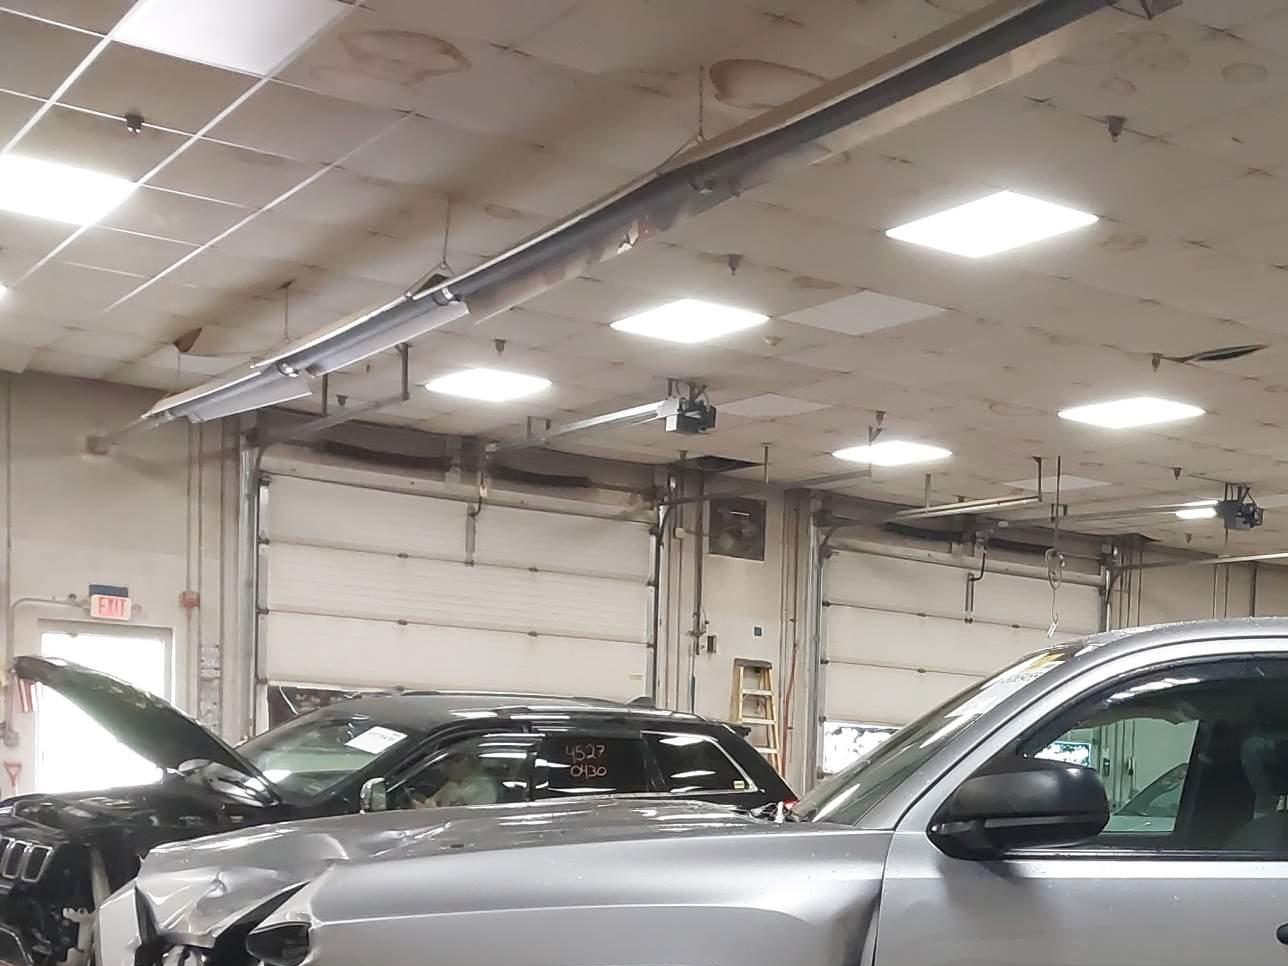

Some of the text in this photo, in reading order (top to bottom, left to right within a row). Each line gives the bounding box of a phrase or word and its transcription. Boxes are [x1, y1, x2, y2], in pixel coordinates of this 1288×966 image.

[98, 596, 127, 617] EXIT
[565, 744, 606, 764] 4527
[570, 763, 608, 780] 0430
